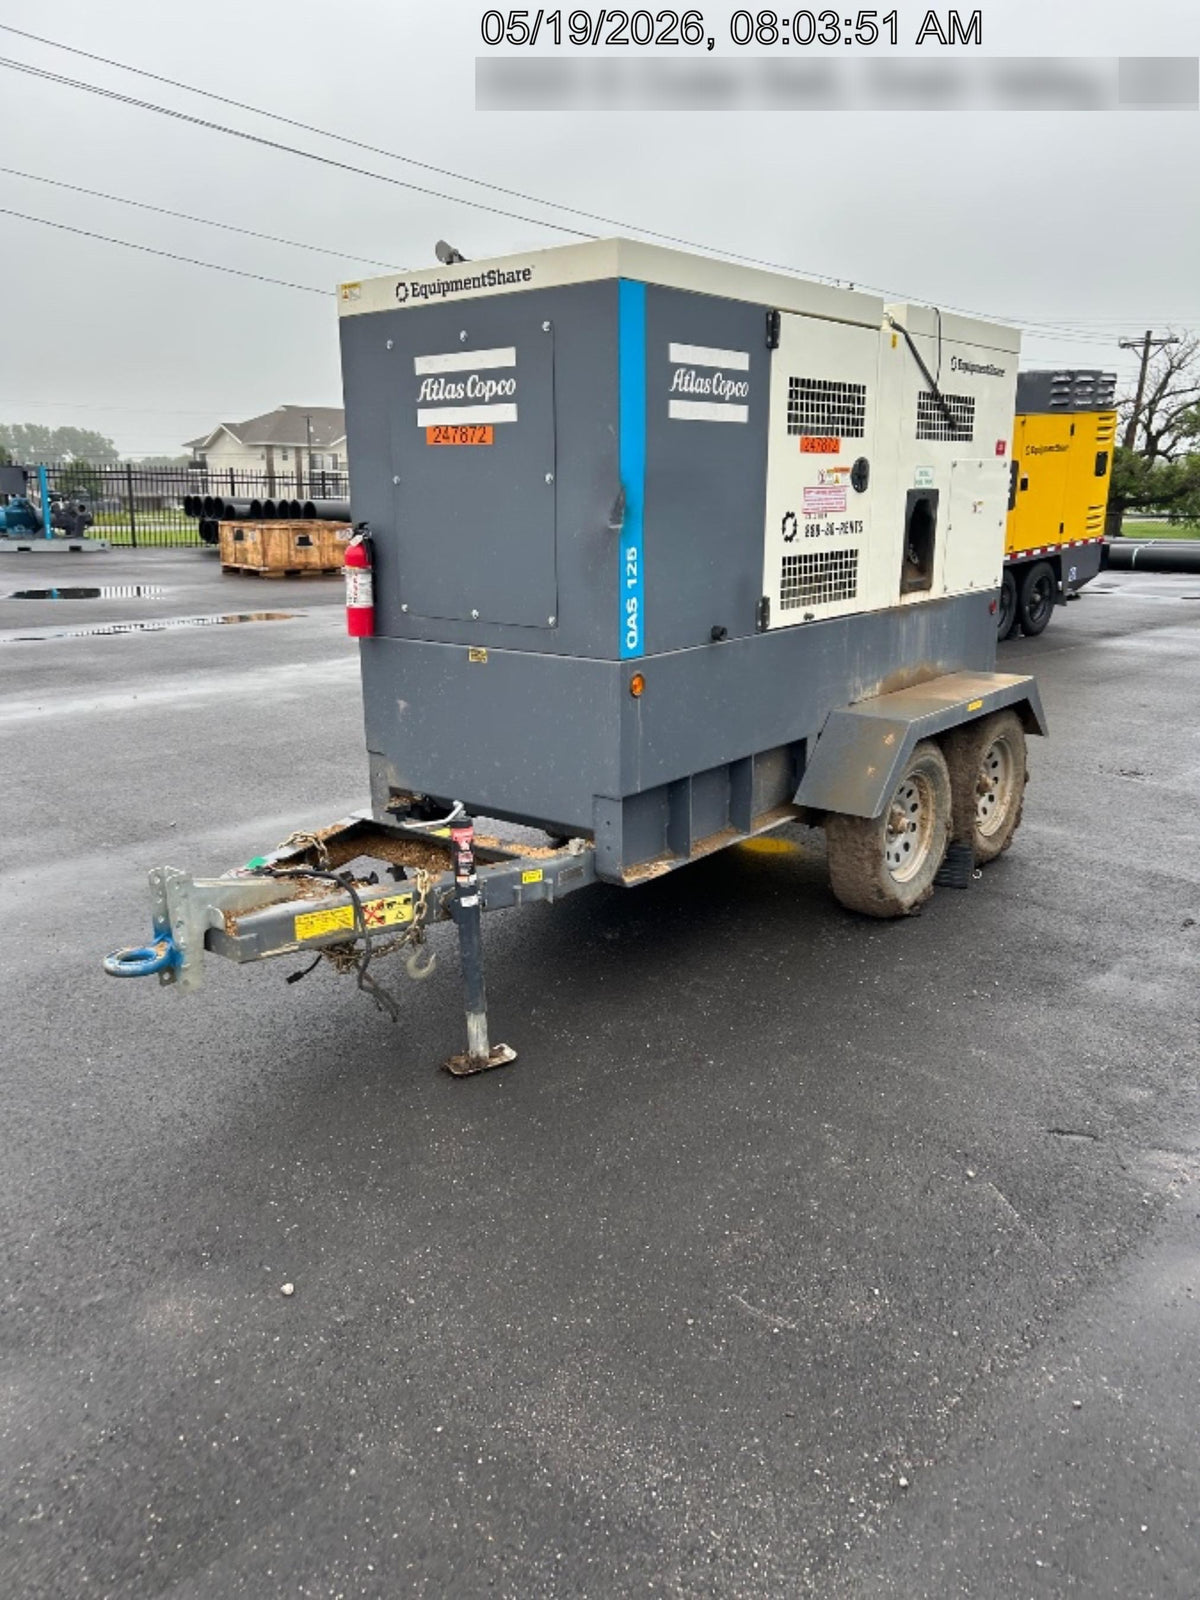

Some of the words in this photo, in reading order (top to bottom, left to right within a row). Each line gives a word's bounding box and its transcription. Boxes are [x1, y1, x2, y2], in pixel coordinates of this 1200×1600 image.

[410, 267, 532, 299] EquipmentShare
[416, 377, 465, 402] Atlas
[466, 374, 517, 403] Copco
[669, 367, 711, 394] Atlas
[712, 371, 750, 401] Copco
[433, 425, 487, 444] 247872
